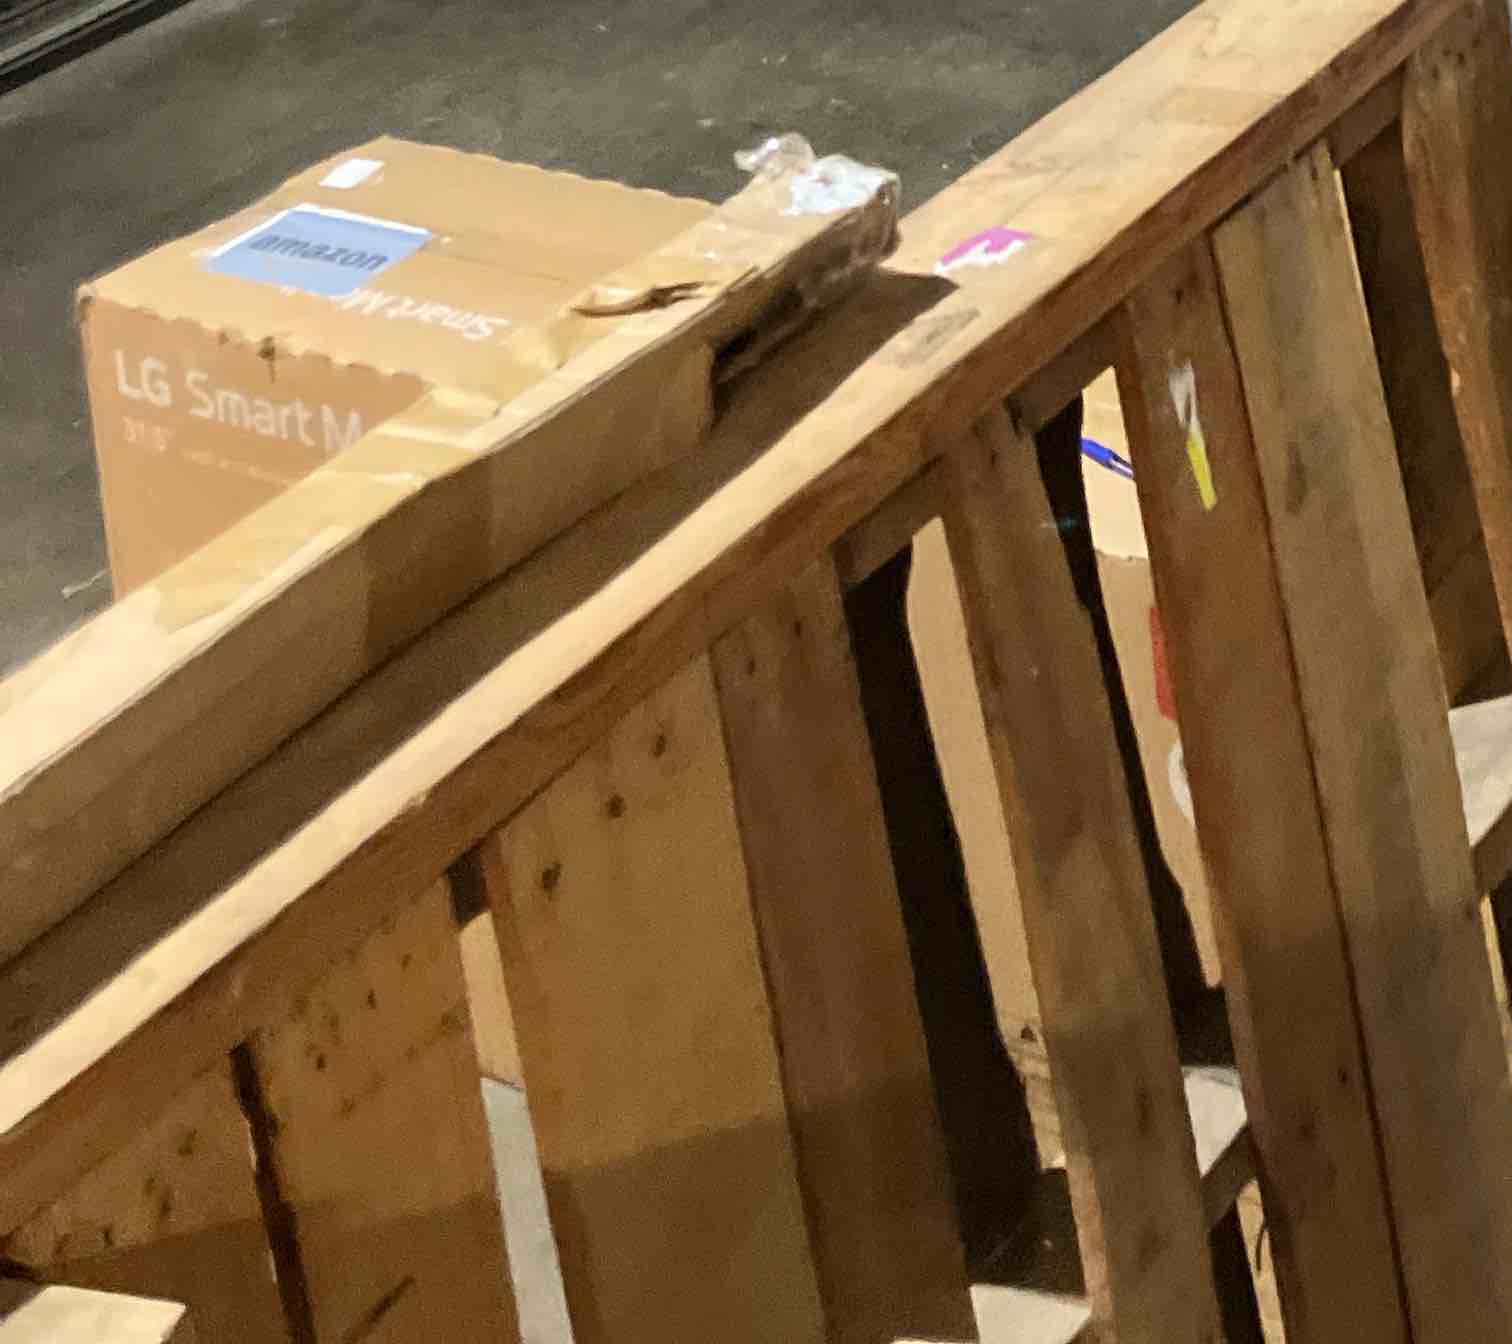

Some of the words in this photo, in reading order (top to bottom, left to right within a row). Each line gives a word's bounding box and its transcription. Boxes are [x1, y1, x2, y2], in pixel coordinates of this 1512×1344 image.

[250, 235, 389, 272] amazon
[114, 348, 172, 408] LG
[183, 367, 316, 447] Smart
